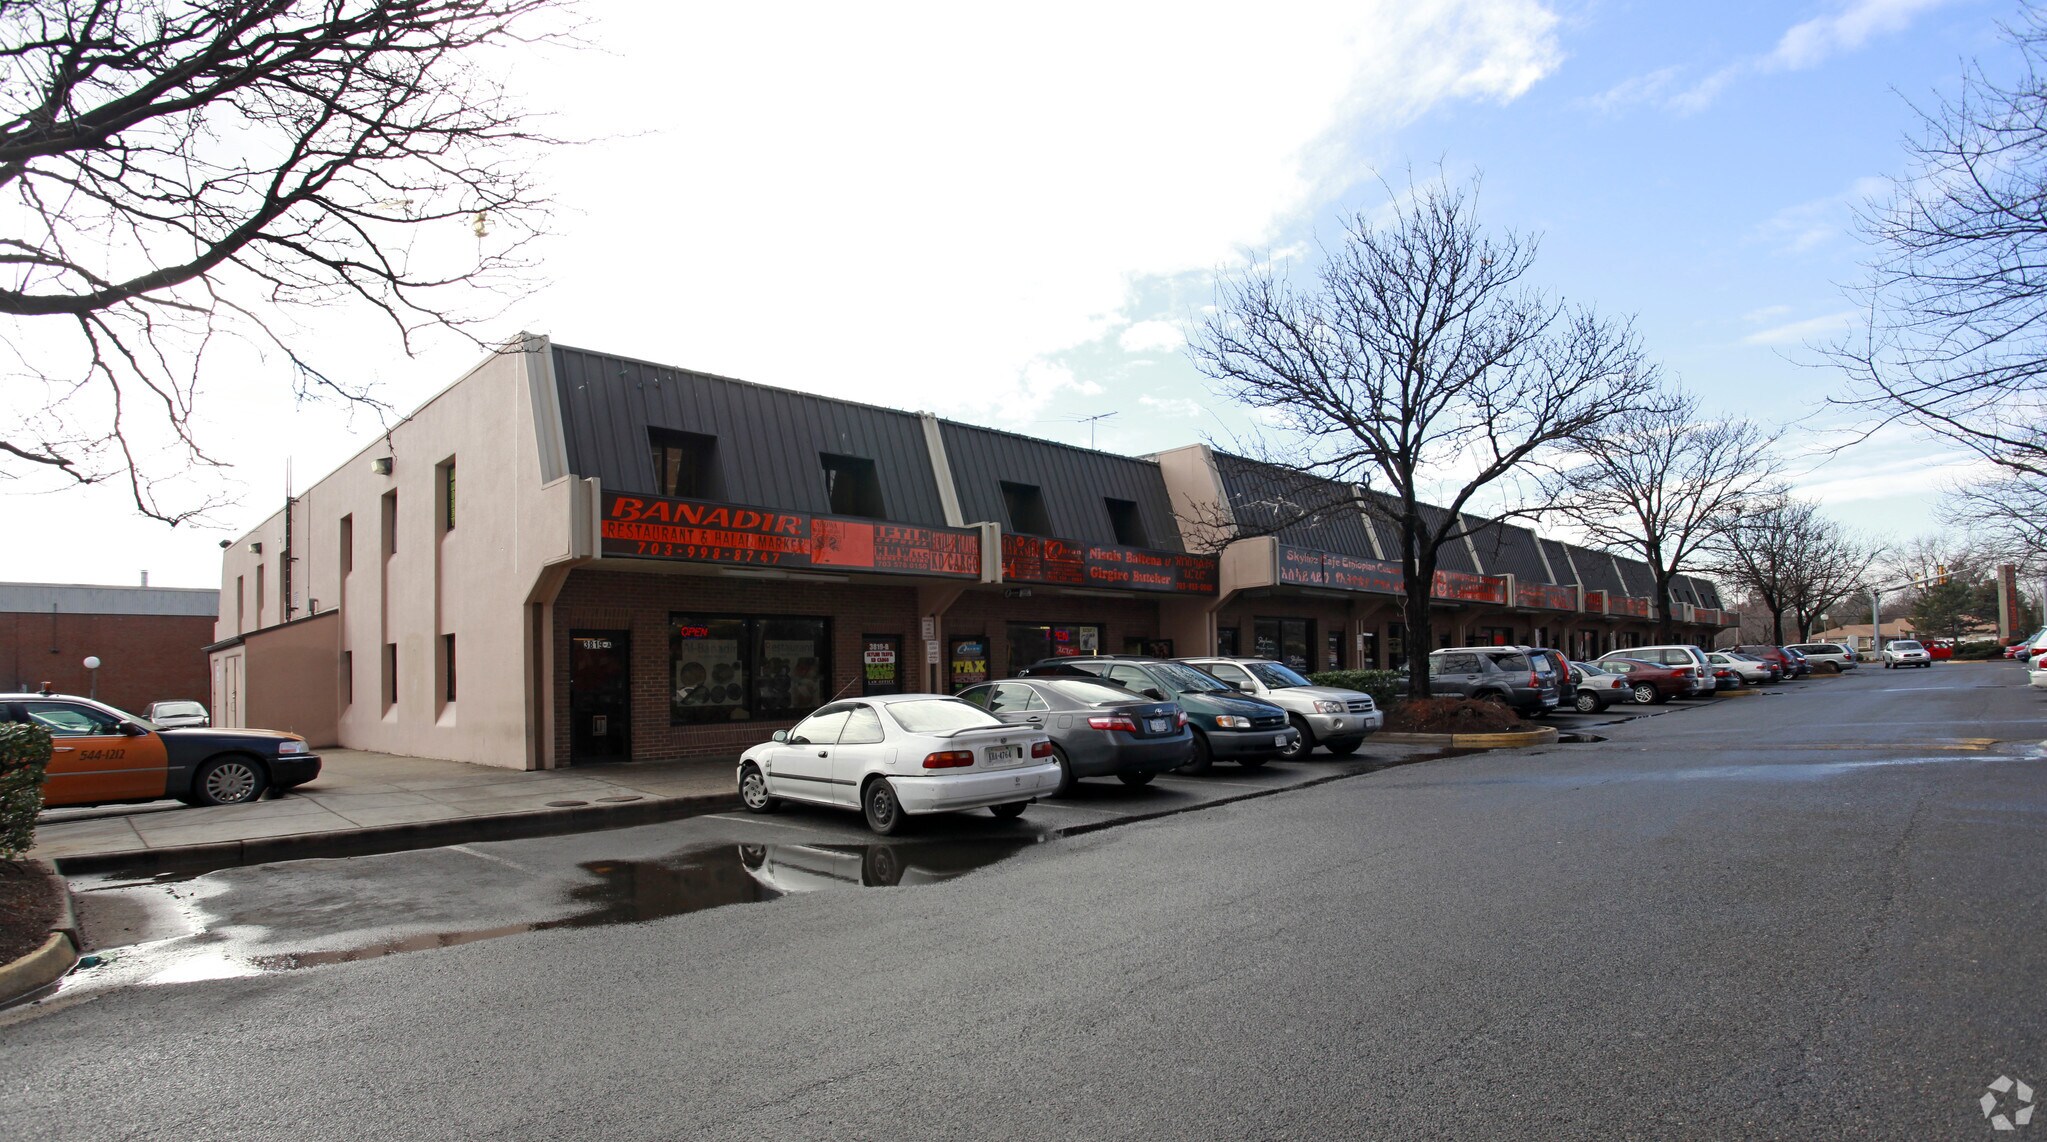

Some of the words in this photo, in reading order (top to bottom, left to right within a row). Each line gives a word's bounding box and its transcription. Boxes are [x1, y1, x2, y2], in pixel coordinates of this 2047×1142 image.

[611, 497, 802, 535] BANADIR
[607, 522, 694, 544] RESTAURANT
[700, 530, 708, 545] &
[715, 532, 754, 550] HALAL
[947, 553, 980, 573] CARGO
[1132, 570, 1172, 585] Butcher
[681, 626, 709, 638] OPEN
[952, 660, 986, 673] TAX
